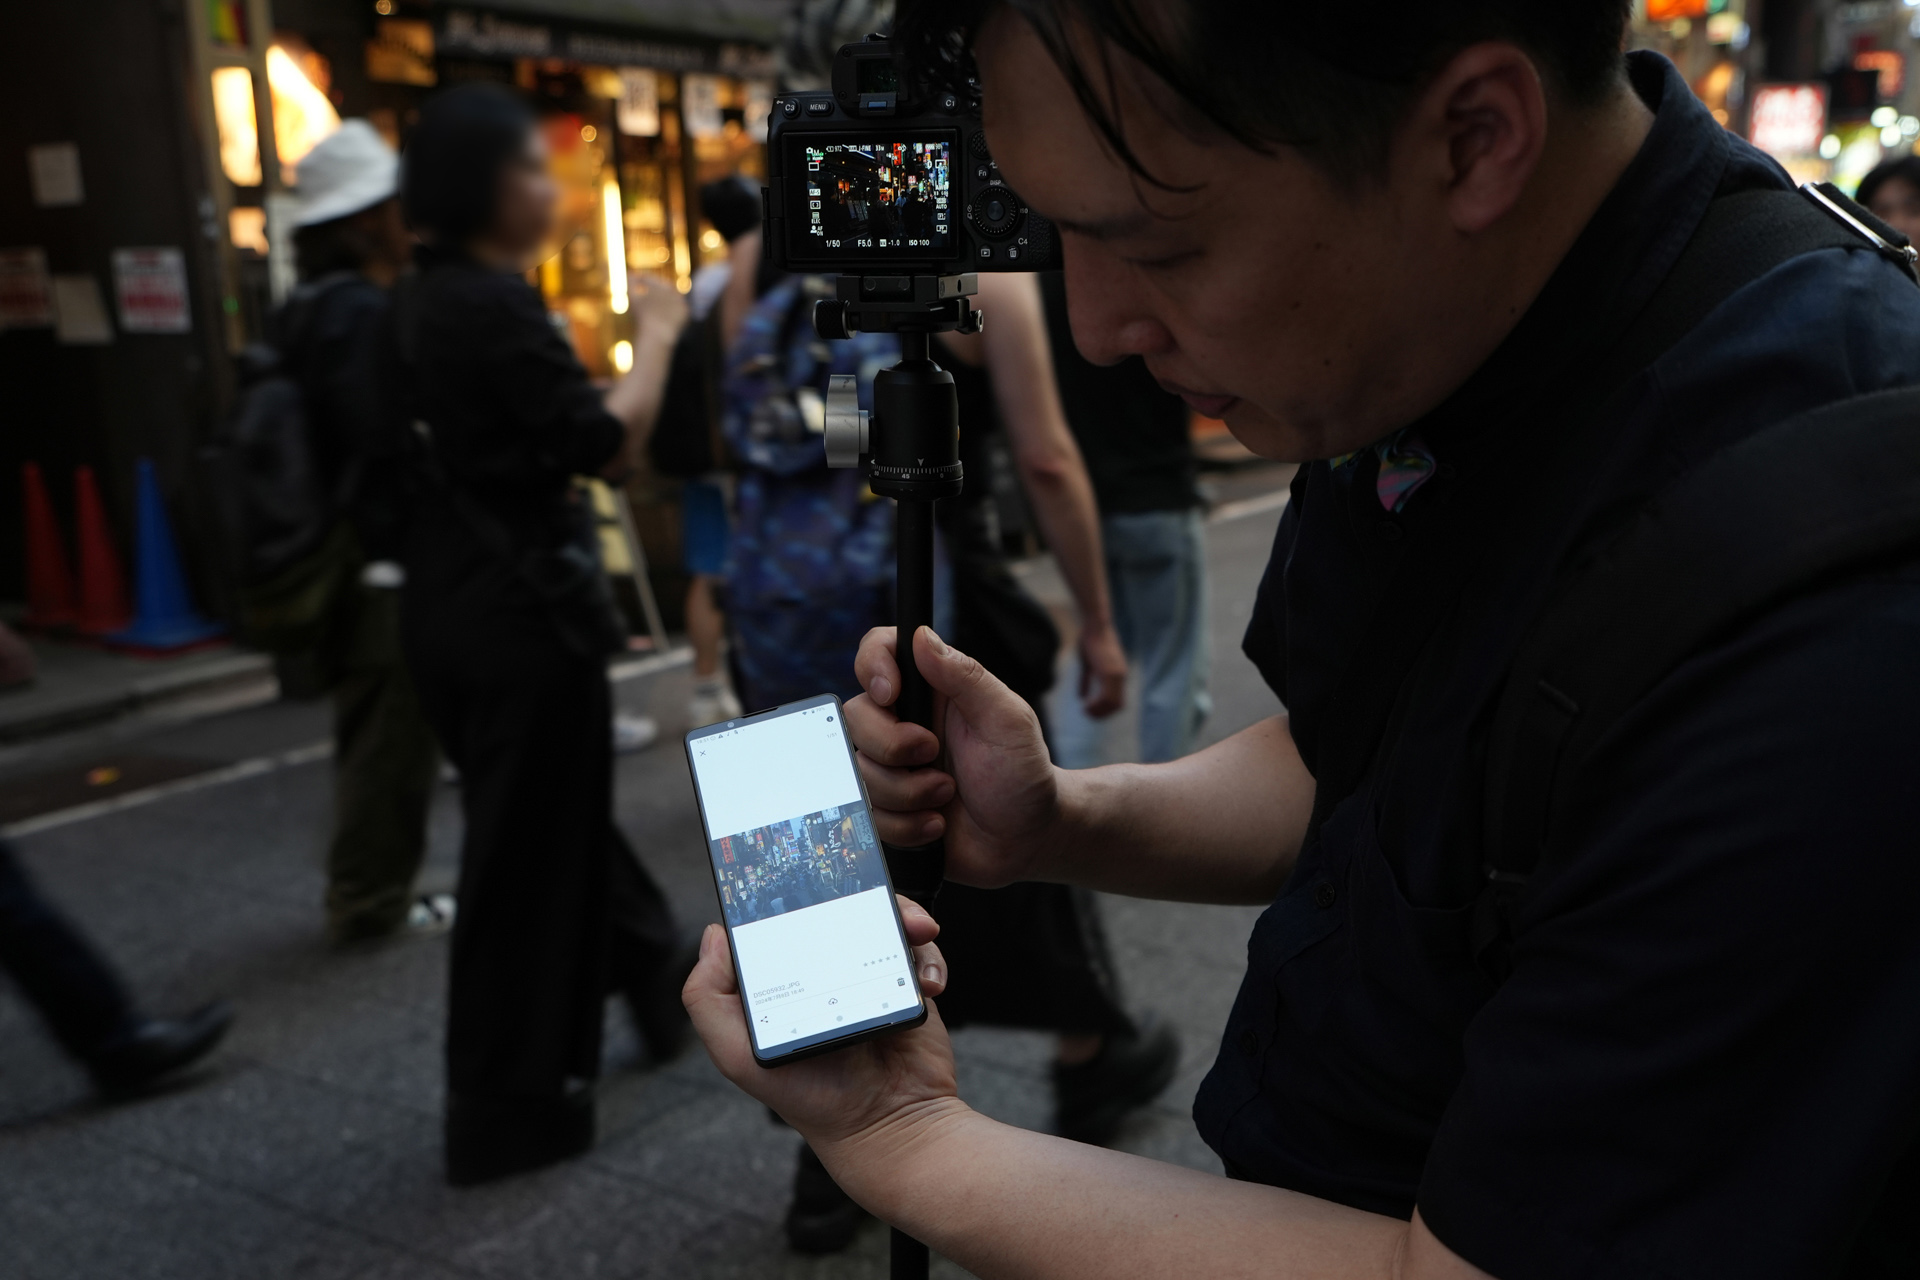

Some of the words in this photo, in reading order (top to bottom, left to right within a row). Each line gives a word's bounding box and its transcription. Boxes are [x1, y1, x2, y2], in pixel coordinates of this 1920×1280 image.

[945, 99, 955, 107] C1
[826, 239, 841, 247] 1/50
[857, 239, 872, 247] F5.0
[1018, 237, 1028, 245] C4
